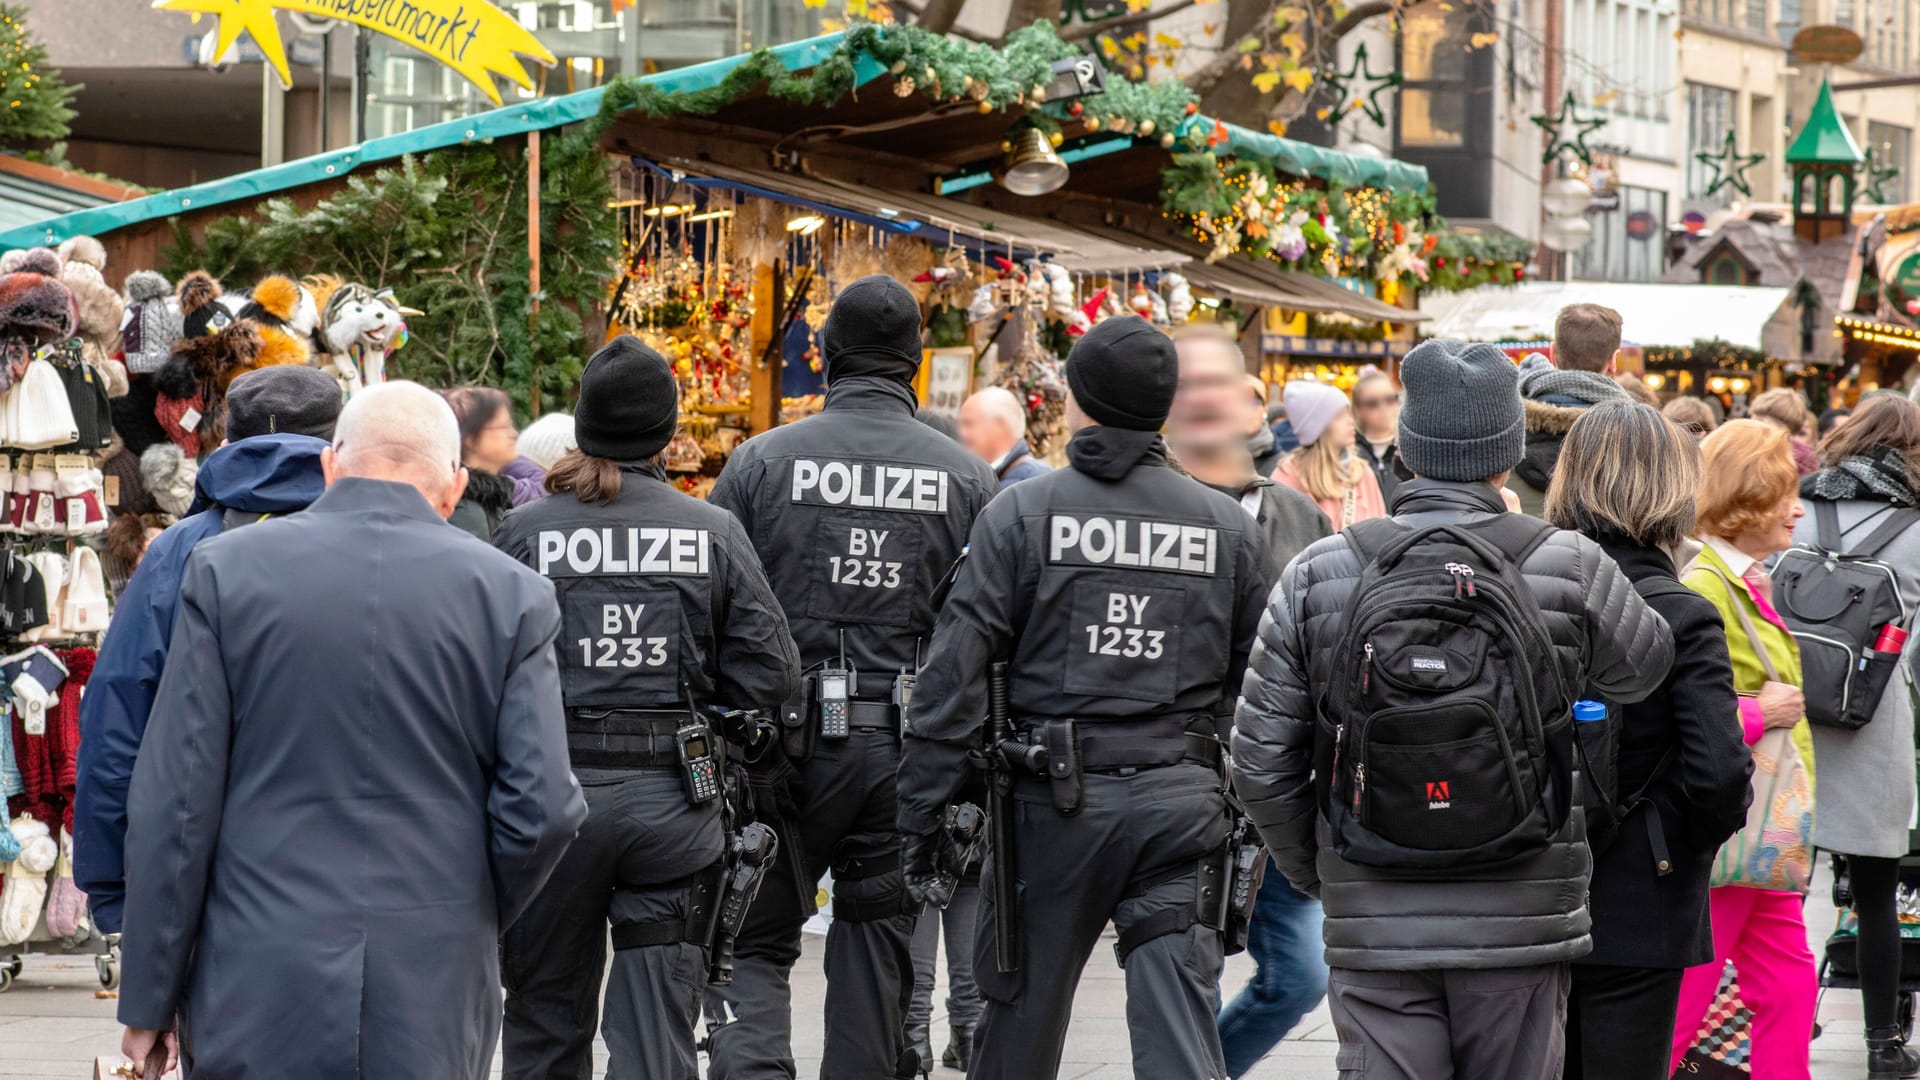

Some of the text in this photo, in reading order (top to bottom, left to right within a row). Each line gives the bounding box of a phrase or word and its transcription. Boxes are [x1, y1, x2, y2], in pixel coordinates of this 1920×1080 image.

[792, 459, 949, 513] POLIZEI
[538, 528, 709, 575] POLIZEI
[849, 527, 888, 557] BY
[1050, 514, 1217, 574] POLIZEI
[829, 556, 902, 588] 1233
[603, 604, 645, 634] BY
[1107, 593, 1151, 625] BY
[578, 636, 667, 667] 1233
[1086, 625, 1165, 659] 1233
